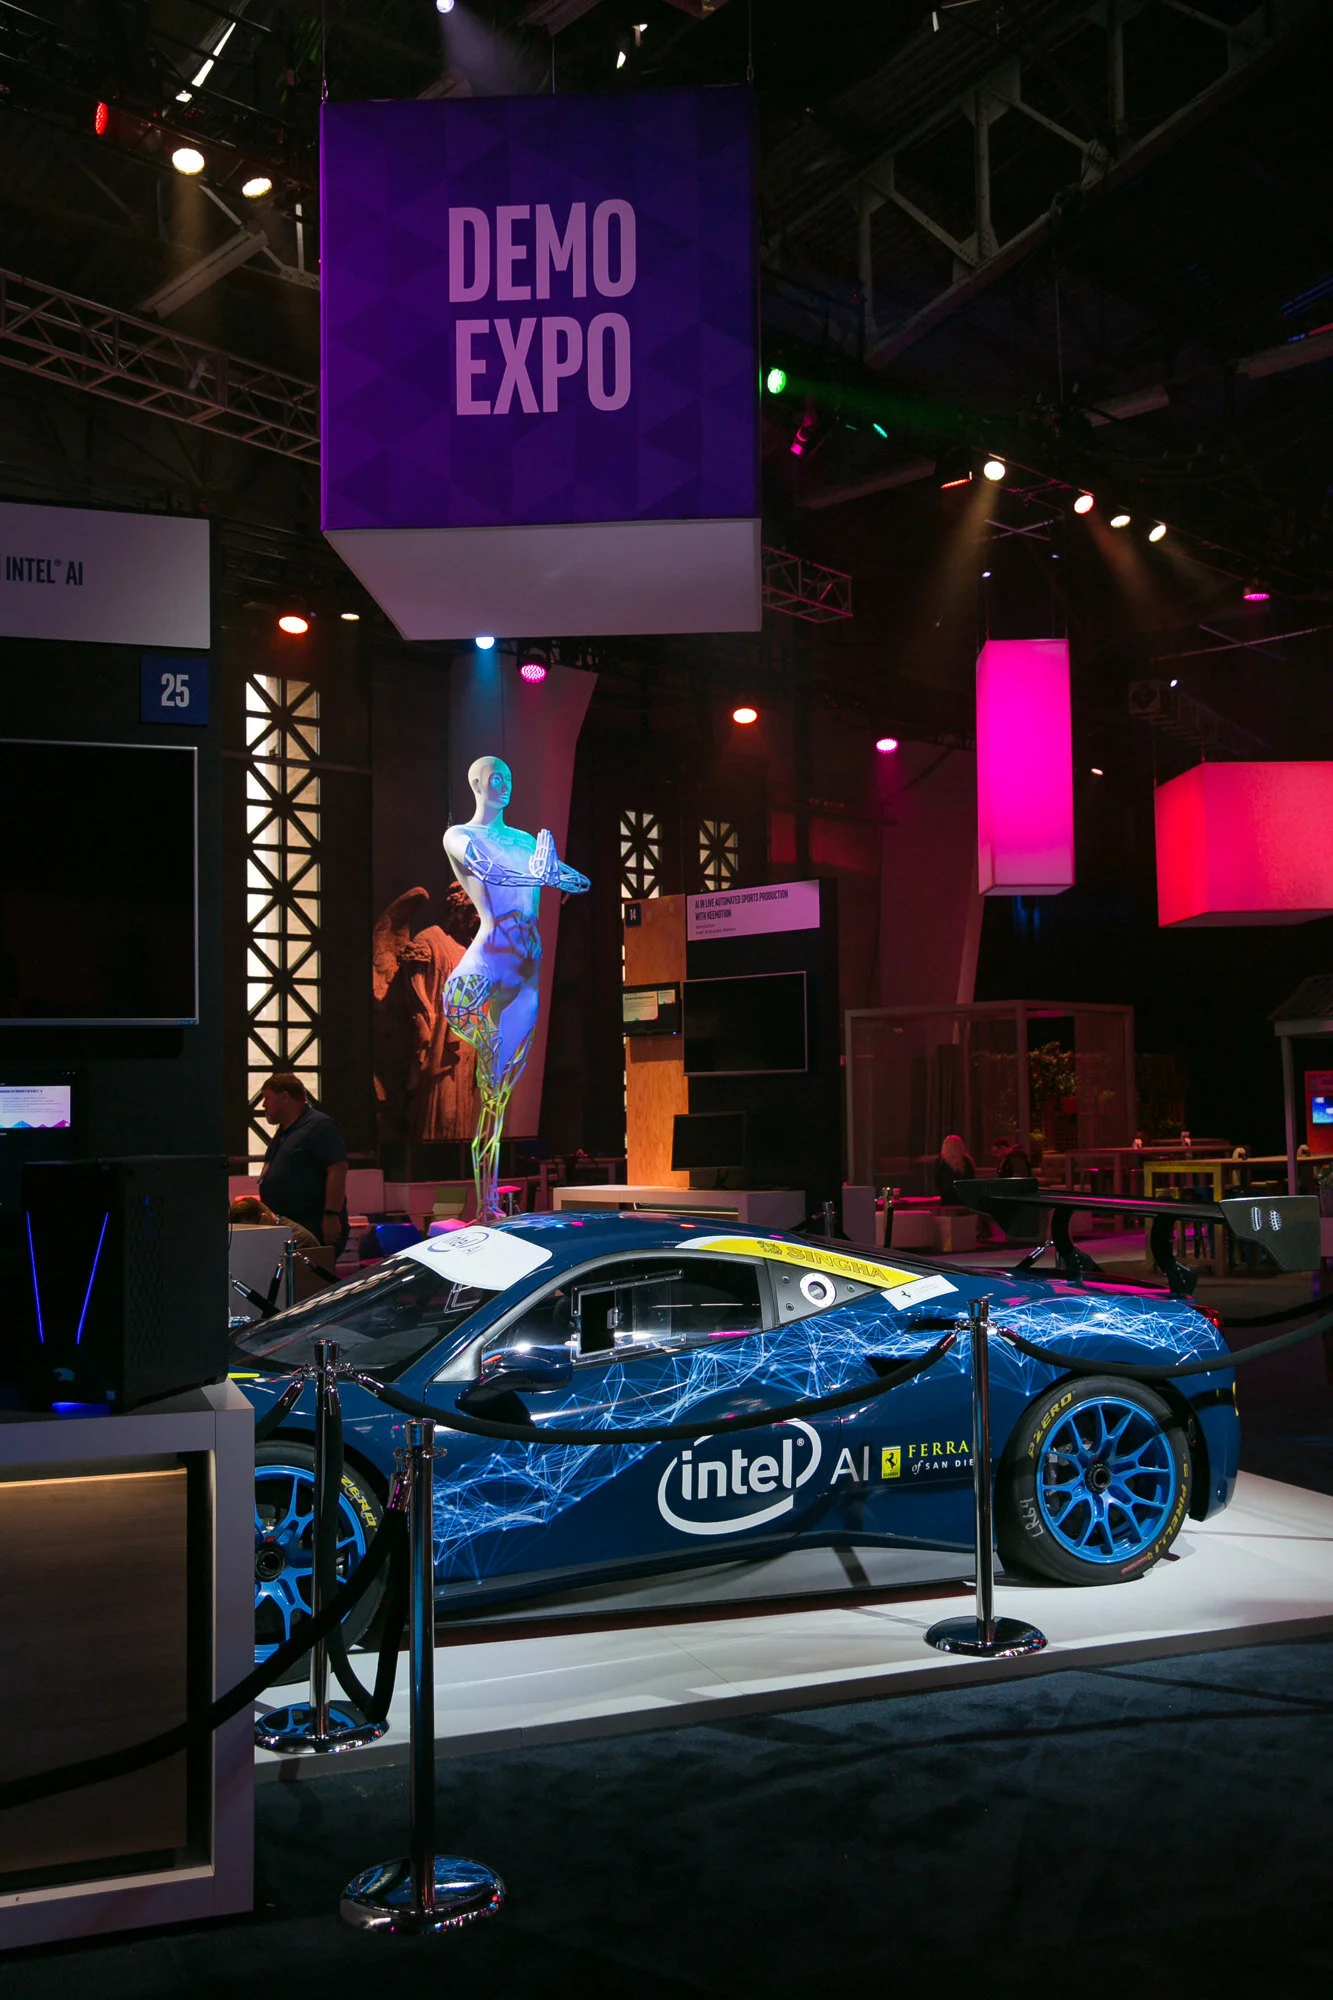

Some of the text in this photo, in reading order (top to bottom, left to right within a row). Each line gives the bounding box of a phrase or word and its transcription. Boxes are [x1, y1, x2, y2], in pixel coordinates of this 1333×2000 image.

[448, 199, 637, 303] DEMO
[455, 312, 632, 416] EXPO
[65, 560, 84, 586] AI
[161, 672, 190, 708] 25
[705, 898, 715, 908] LIVE
[715, 895, 741, 907] AUTOMATED
[741, 893, 759, 904] SPORTS
[759, 889, 789, 902] PRODUCTION
[629, 908, 637, 921] 14
[695, 911, 707, 921] WITH
[786, 1246, 889, 1282] SINGHA
[830, 1445, 870, 1485] AI
[908, 1440, 970, 1459] FERRA
[911, 1460, 923, 1476] of
[925, 1460, 949, 1471] SAN
[1152, 1483, 1187, 1555] PIRELLI
